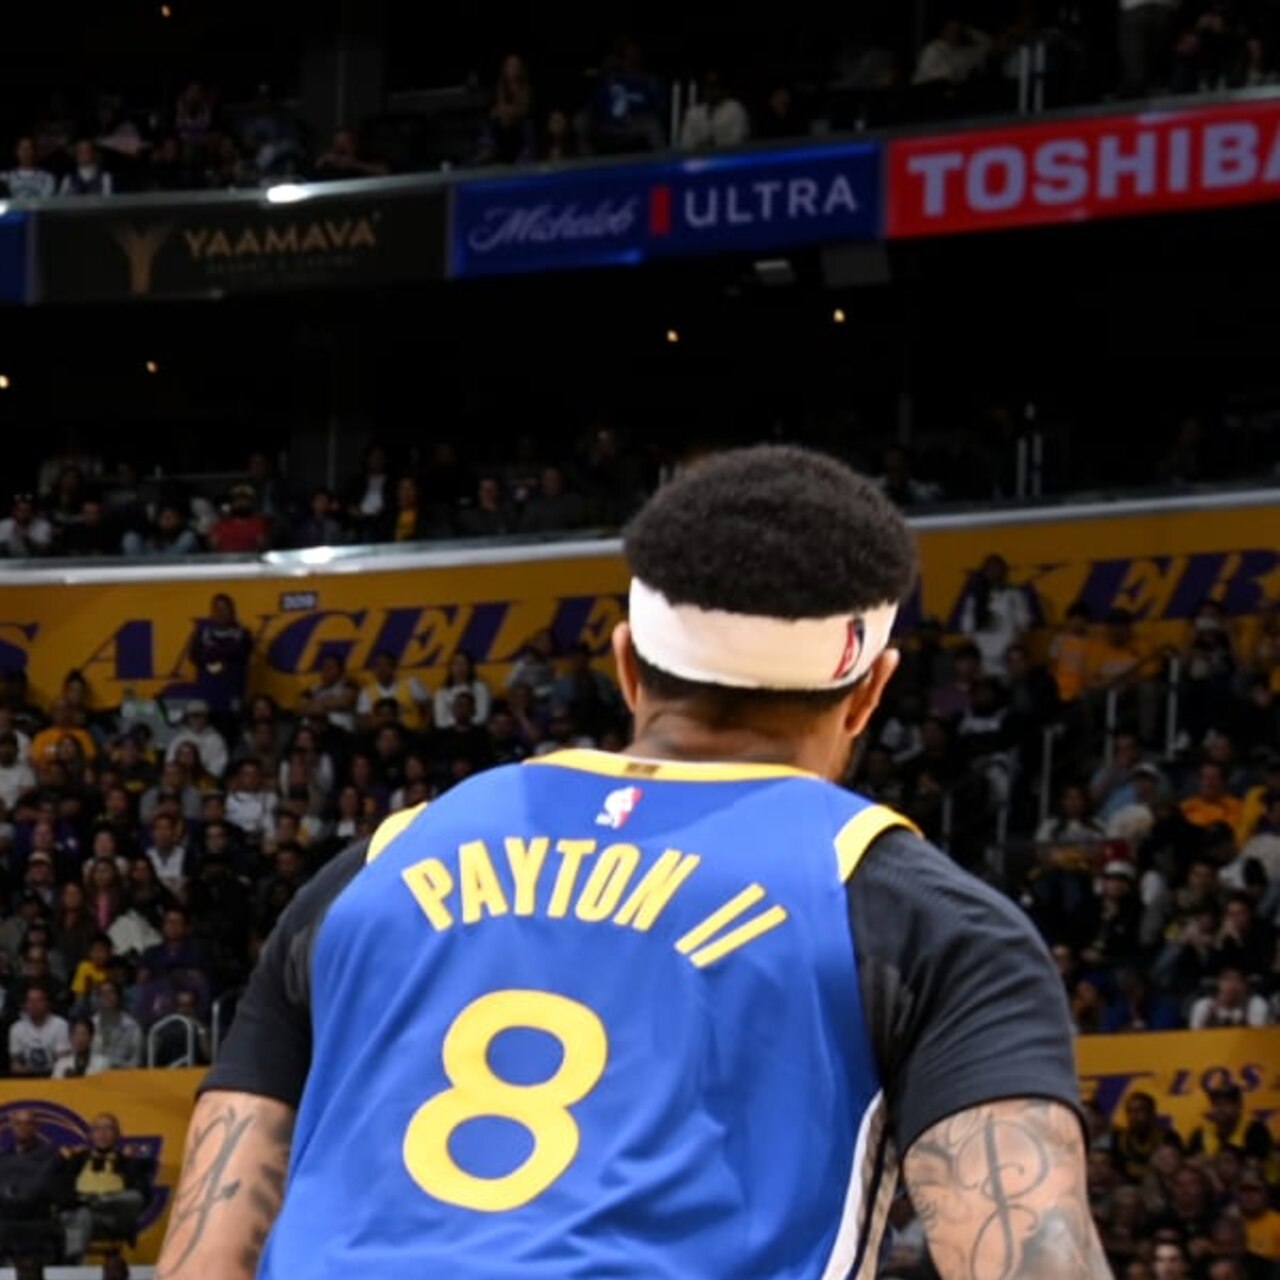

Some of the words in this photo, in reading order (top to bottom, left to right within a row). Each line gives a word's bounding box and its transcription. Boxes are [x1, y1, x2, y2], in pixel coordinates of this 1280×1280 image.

[684, 174, 858, 228] ULTRA
[400, 835, 702, 933] PAYTON
[674, 881, 789, 969] II
[401, 988, 609, 1214] 8
